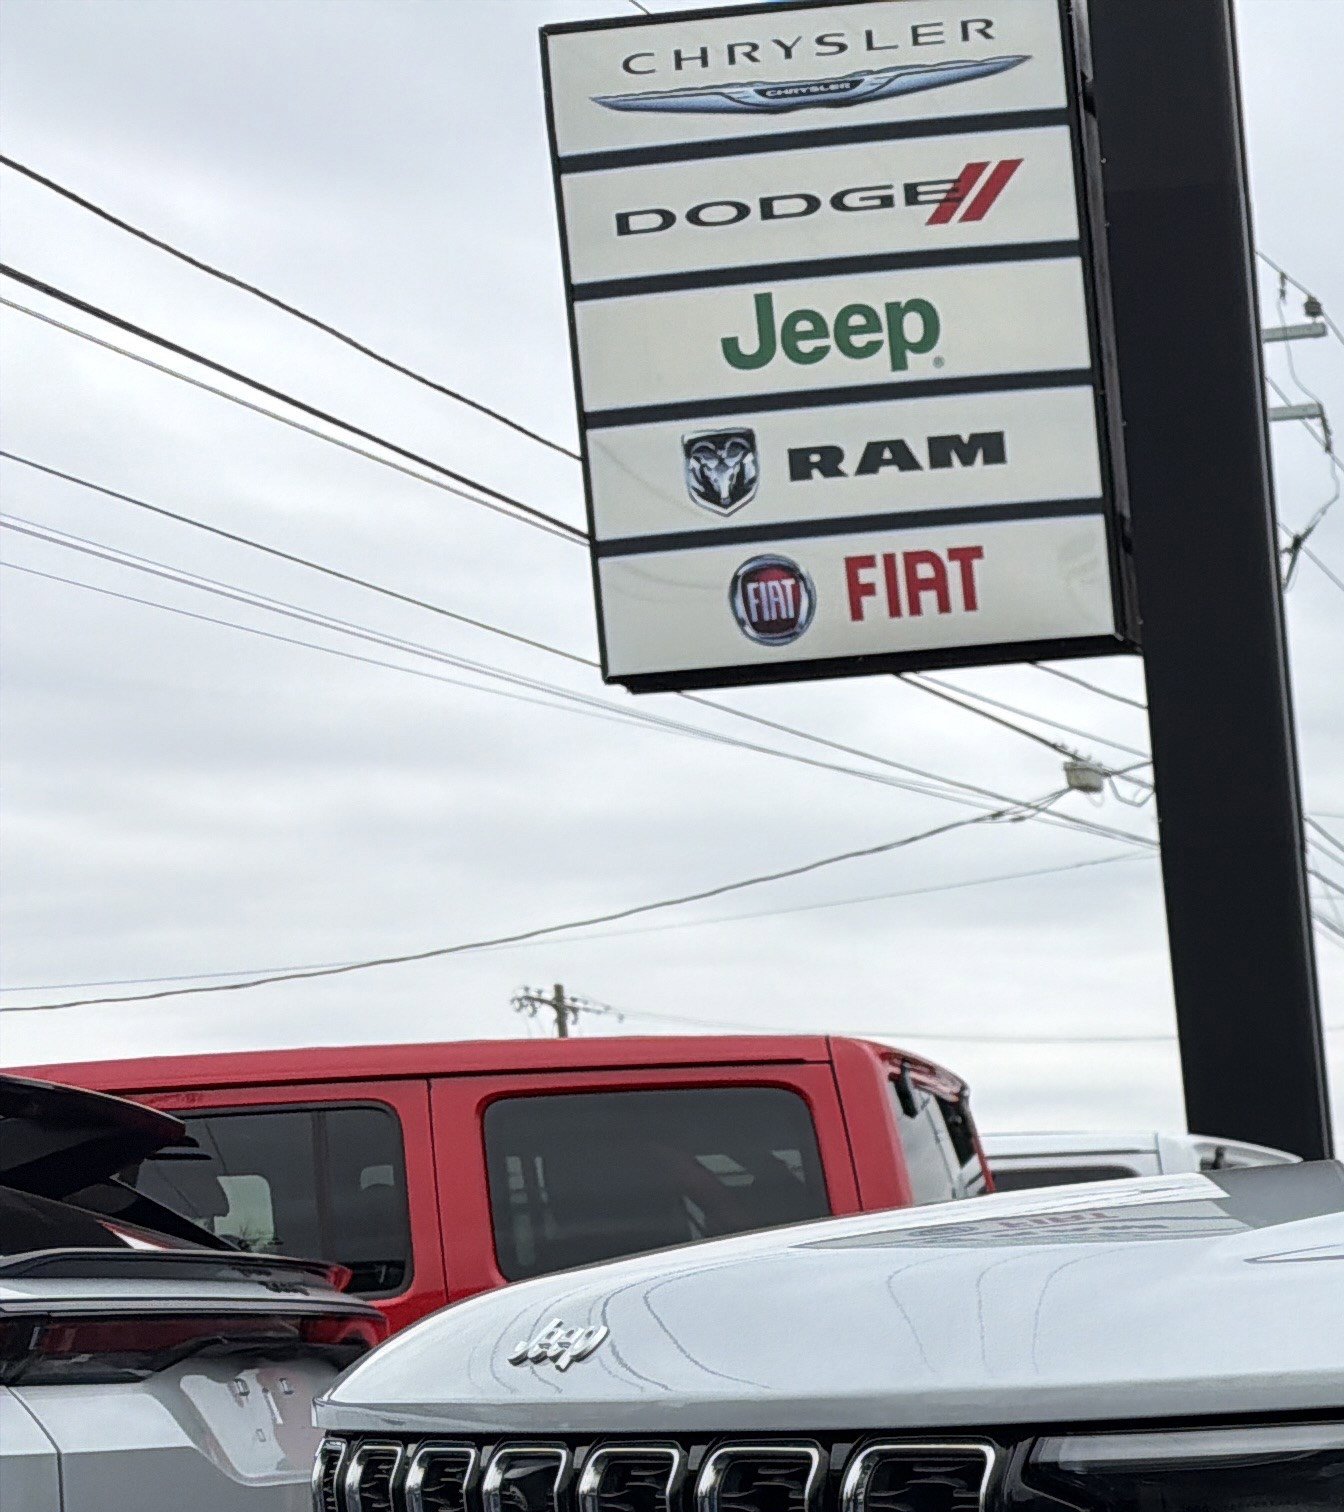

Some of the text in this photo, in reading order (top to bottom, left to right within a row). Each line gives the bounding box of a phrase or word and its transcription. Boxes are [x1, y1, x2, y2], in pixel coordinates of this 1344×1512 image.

[622, 18, 995, 75] CHRYSLER
[615, 178, 963, 236] DODGE
[721, 291, 941, 372] Jeep
[787, 431, 1007, 482] RAM
[747, 578, 798, 623] FIAT
[845, 545, 984, 622] FIAT
[507, 1317, 611, 1373] Jeep
